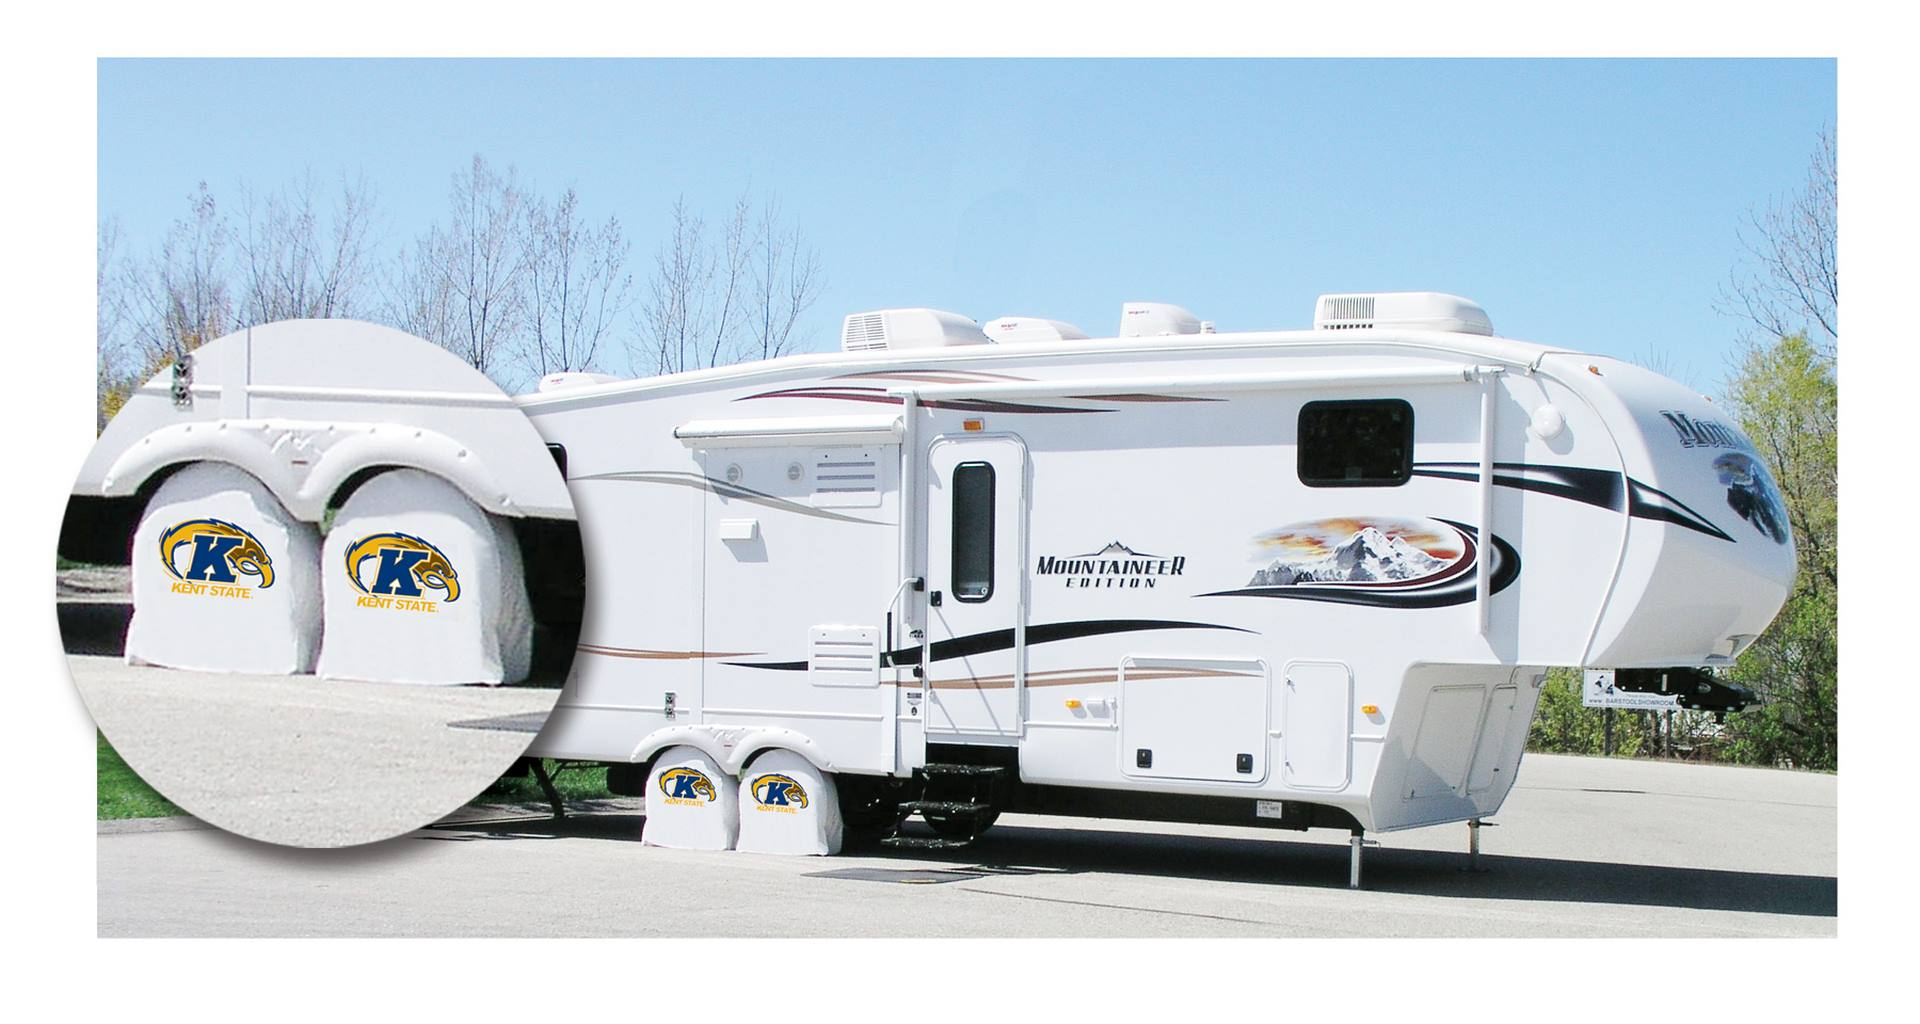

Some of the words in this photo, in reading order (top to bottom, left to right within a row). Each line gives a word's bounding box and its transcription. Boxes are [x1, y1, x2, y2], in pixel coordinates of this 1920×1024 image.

[1037, 556, 1185, 575] MOUNTAINEER
[171, 582, 208, 595] KENT
[1066, 577, 1156, 588] EDITION
[356, 596, 393, 609] KENT
